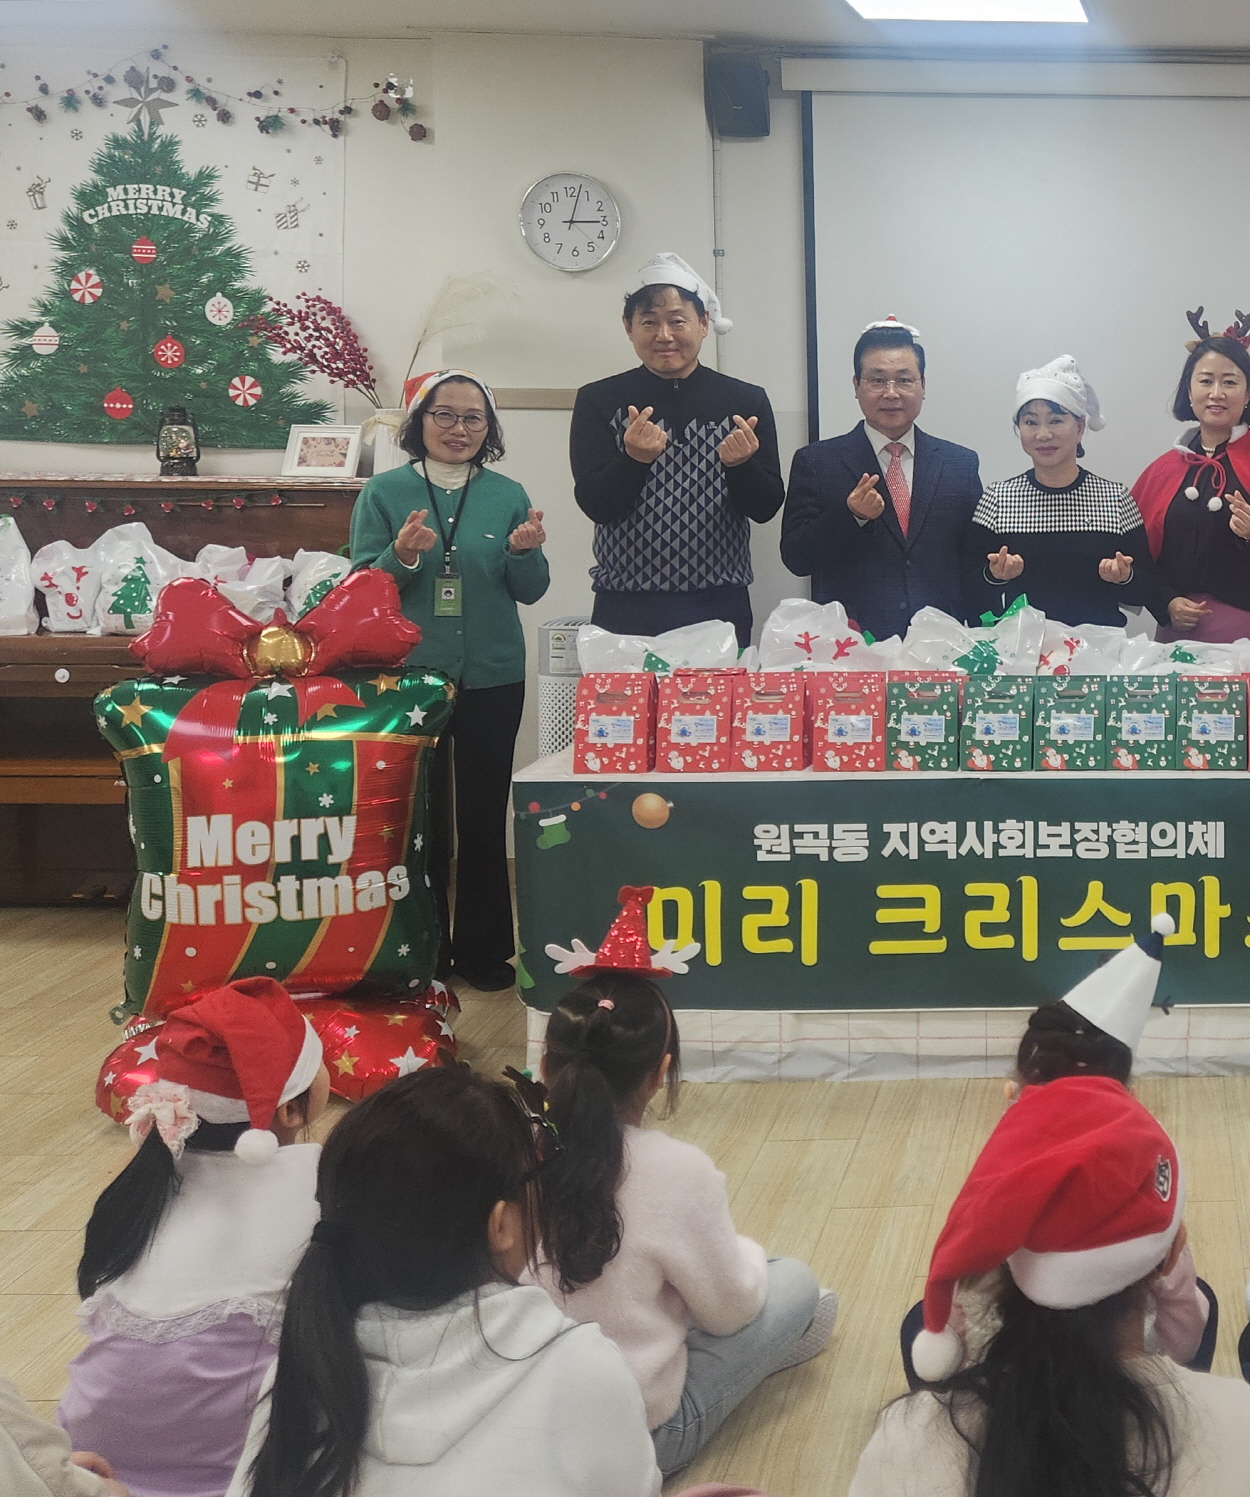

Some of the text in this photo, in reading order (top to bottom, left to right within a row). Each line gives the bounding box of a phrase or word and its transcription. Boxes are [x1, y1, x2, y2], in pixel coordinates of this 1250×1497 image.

[106, 184, 187, 204] MERRY
[550, 191, 559, 203] 11
[563, 186, 577, 198] 12
[585, 190, 590, 202] 1
[538, 202, 552, 214] 10
[596, 200, 604, 212] 2
[82, 198, 212, 229] CHRISTMAS
[537, 218, 546, 230] 9
[600, 215, 609, 227] 3
[543, 232, 551, 244] 8
[597, 230, 605, 241] 4
[555, 242, 563, 255] 7
[571, 246, 580, 258] 6
[587, 241, 595, 253] 5
[186, 813, 358, 869] Merry
[753, 819, 1225, 862] 원곡동 지역사회보장협의체
[140, 864, 411, 927] Christmas
[647, 878, 819, 967] 미리
